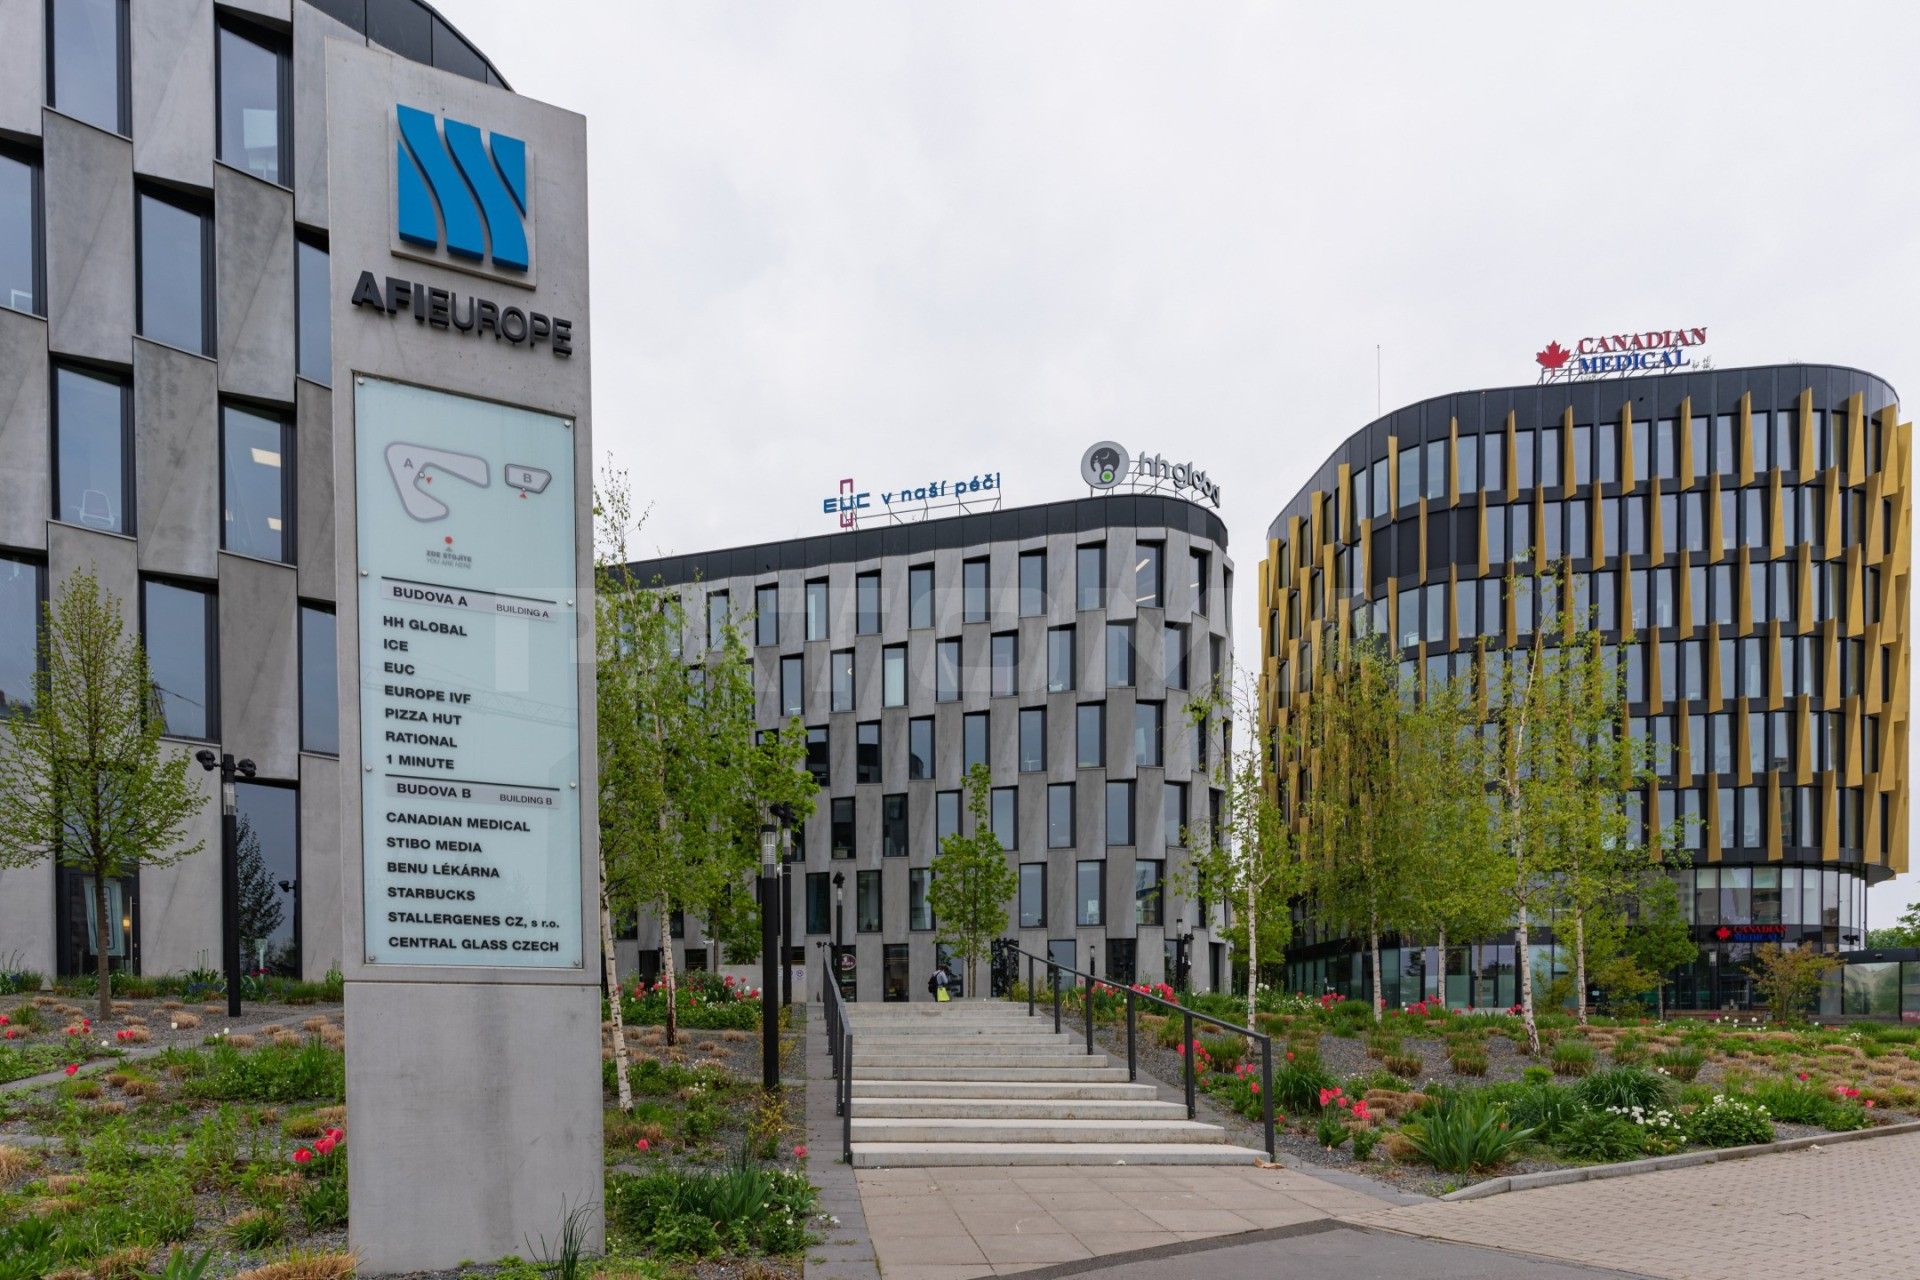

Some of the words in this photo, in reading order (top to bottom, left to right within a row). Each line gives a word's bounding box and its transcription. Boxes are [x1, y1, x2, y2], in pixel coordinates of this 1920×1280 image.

[1578, 327, 1708, 355] CANADIAN
[1578, 349, 1690, 374] MEDICAL
[403, 458, 413, 469] A
[523, 473, 532, 483] B
[823, 493, 870, 513] EUC
[881, 492, 892, 504] v
[901, 480, 947, 502] naší
[393, 586, 454, 605] BUDOVA
[458, 596, 468, 607] A
[496, 603, 541, 617] BUILDING
[542, 610, 549, 618] A
[383, 615, 404, 628] HH
[408, 619, 467, 636] GLOBAL
[383, 638, 409, 651] ICE
[384, 662, 415, 676] EUC
[384, 685, 445, 701] EUROPE
[450, 692, 471, 704] IVF
[385, 708, 428, 722] PIZZA
[433, 713, 462, 726] HUT
[385, 731, 457, 748] RATIONAL
[386, 754, 392, 764] 1
[398, 755, 454, 769] MINUTE
[397, 783, 457, 798] BUDOVA
[462, 788, 472, 798] B
[500, 793, 544, 805] BUILDING
[546, 797, 553, 806] B
[386, 812, 462, 828] CANADIAN
[467, 818, 531, 832] MEDICAL
[386, 837, 431, 849] STIBO
[436, 840, 482, 853] MEDIA
[387, 862, 428, 874] BENU
[433, 862, 500, 878] LÉKÁRNA
[387, 887, 476, 901] STARBUCKS
[388, 912, 500, 926] STALLERGENES
[505, 916, 528, 929] CZ,
[541, 920, 560, 928] r.o.
[389, 936, 457, 949] CENTRAL
[462, 939, 508, 951] GLASS
[512, 940, 559, 952] CZECH
